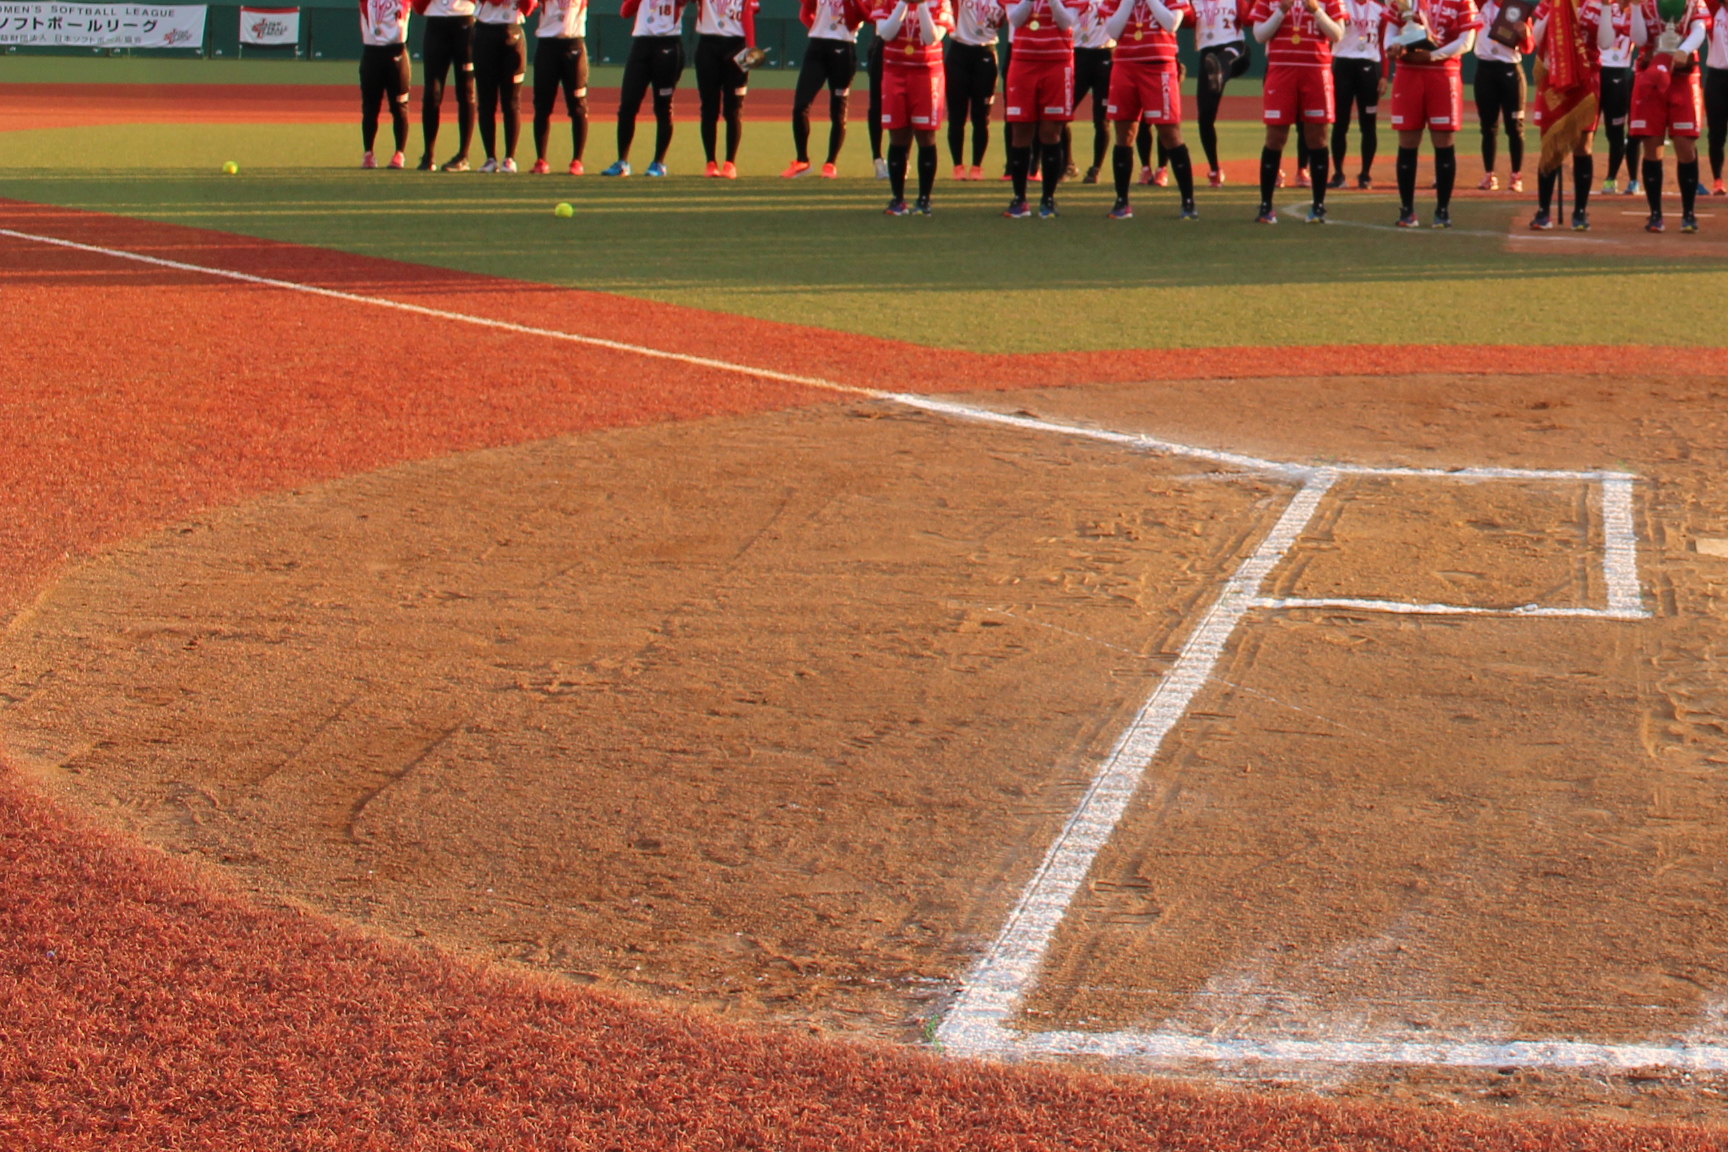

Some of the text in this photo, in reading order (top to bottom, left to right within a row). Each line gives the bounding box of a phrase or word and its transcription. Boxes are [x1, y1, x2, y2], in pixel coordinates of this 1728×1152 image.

[0, 5, 175, 18] MEN'S SOFTBALL LEAGUE
